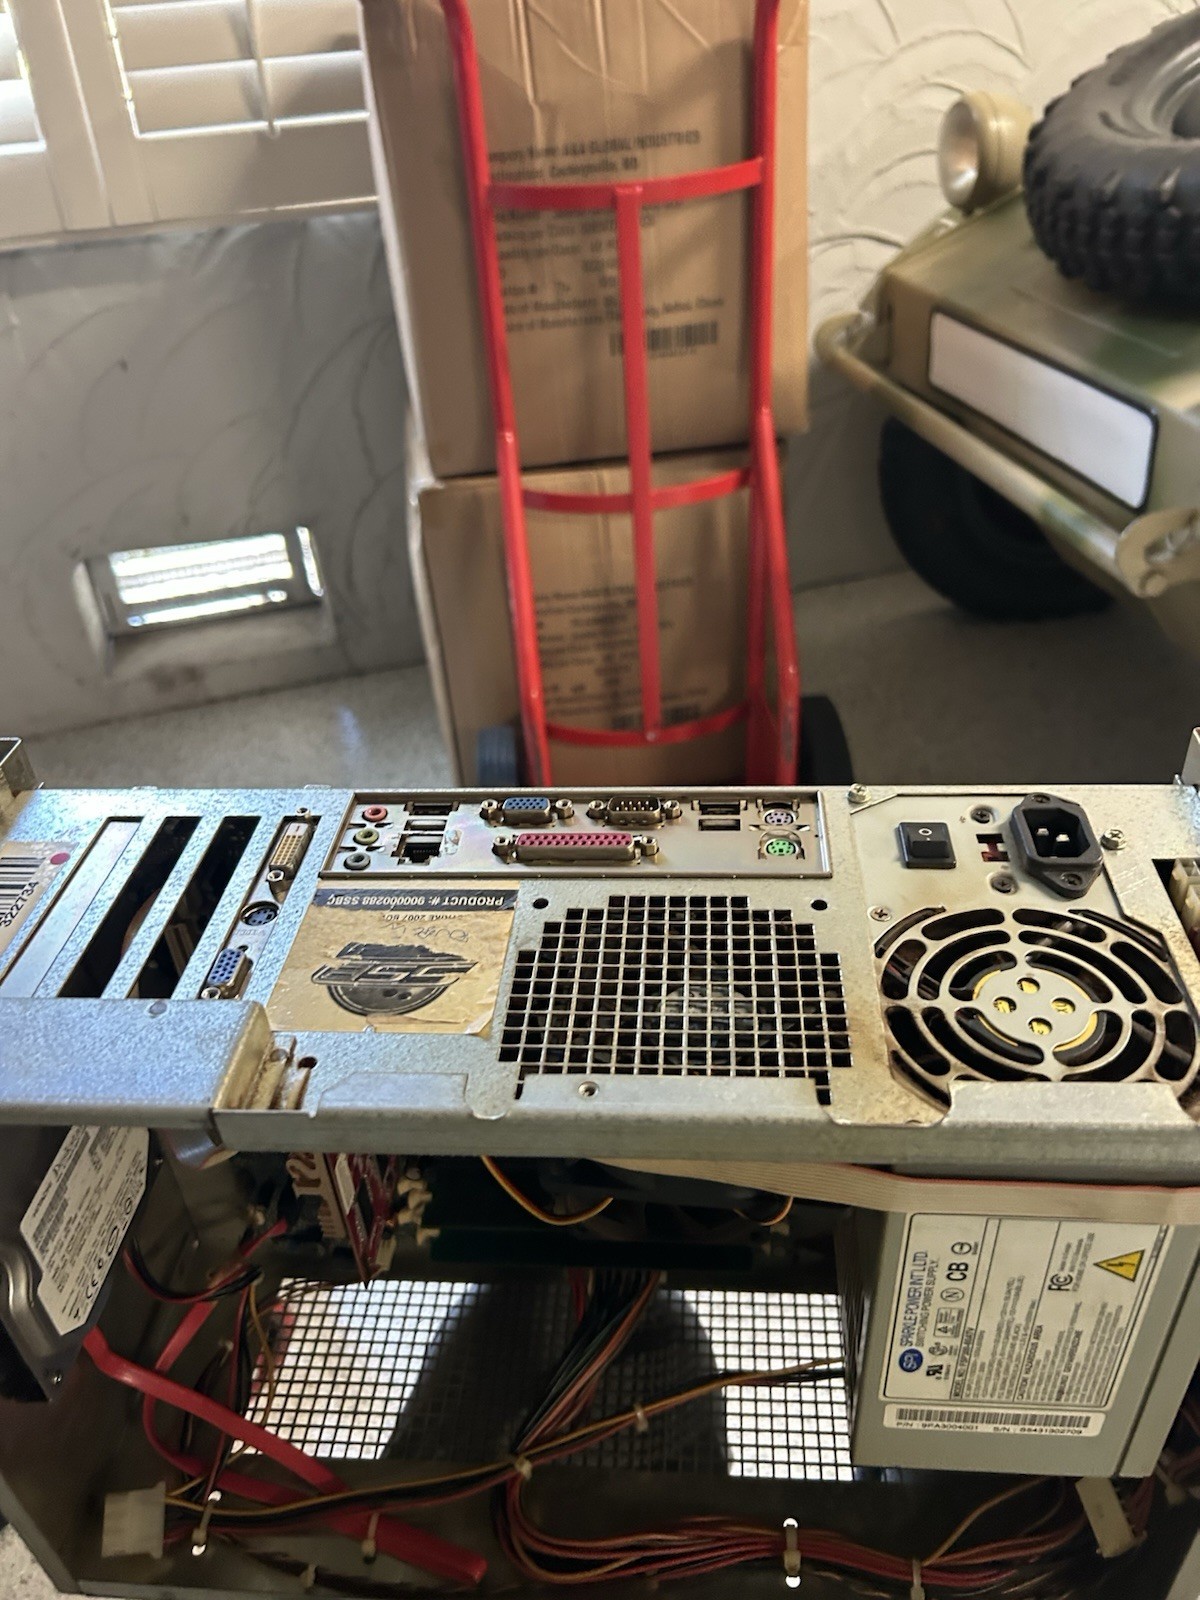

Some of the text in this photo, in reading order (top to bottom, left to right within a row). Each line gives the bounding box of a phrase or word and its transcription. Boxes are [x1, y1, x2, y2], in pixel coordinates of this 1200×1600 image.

[361, 895, 425, 906] 900000288
[428, 896, 440, 905] #:
[443, 896, 504, 906] PRODUCT
[946, 1262, 969, 1281] CB
[904, 1287, 922, 1315] POWER
[921, 1286, 935, 1311] POWER
[900, 1315, 918, 1346] SPARKLE
[915, 1311, 929, 1347] SWITCHING
[1033, 1325, 1043, 1340] AREA
